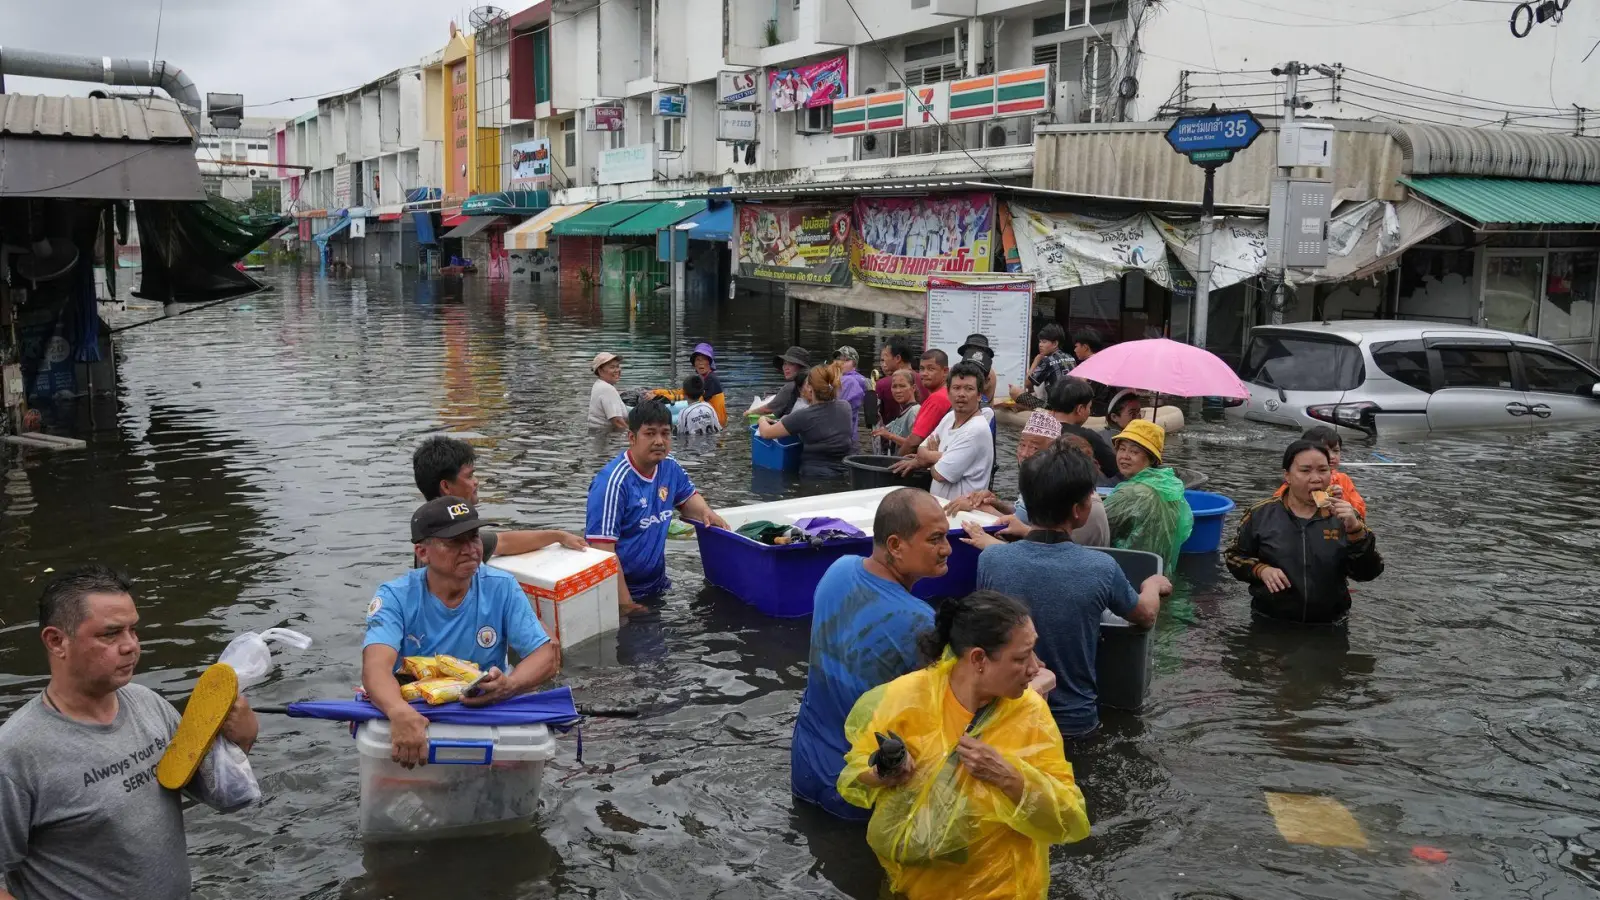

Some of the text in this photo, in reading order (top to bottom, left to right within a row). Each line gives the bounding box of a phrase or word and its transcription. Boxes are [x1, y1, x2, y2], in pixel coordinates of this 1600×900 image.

[919, 88, 934, 123] 7
[1178, 117, 1247, 138] เคหะร่มเกล้า 35
[84, 759, 130, 787] Always
[129, 744, 154, 764] Your
